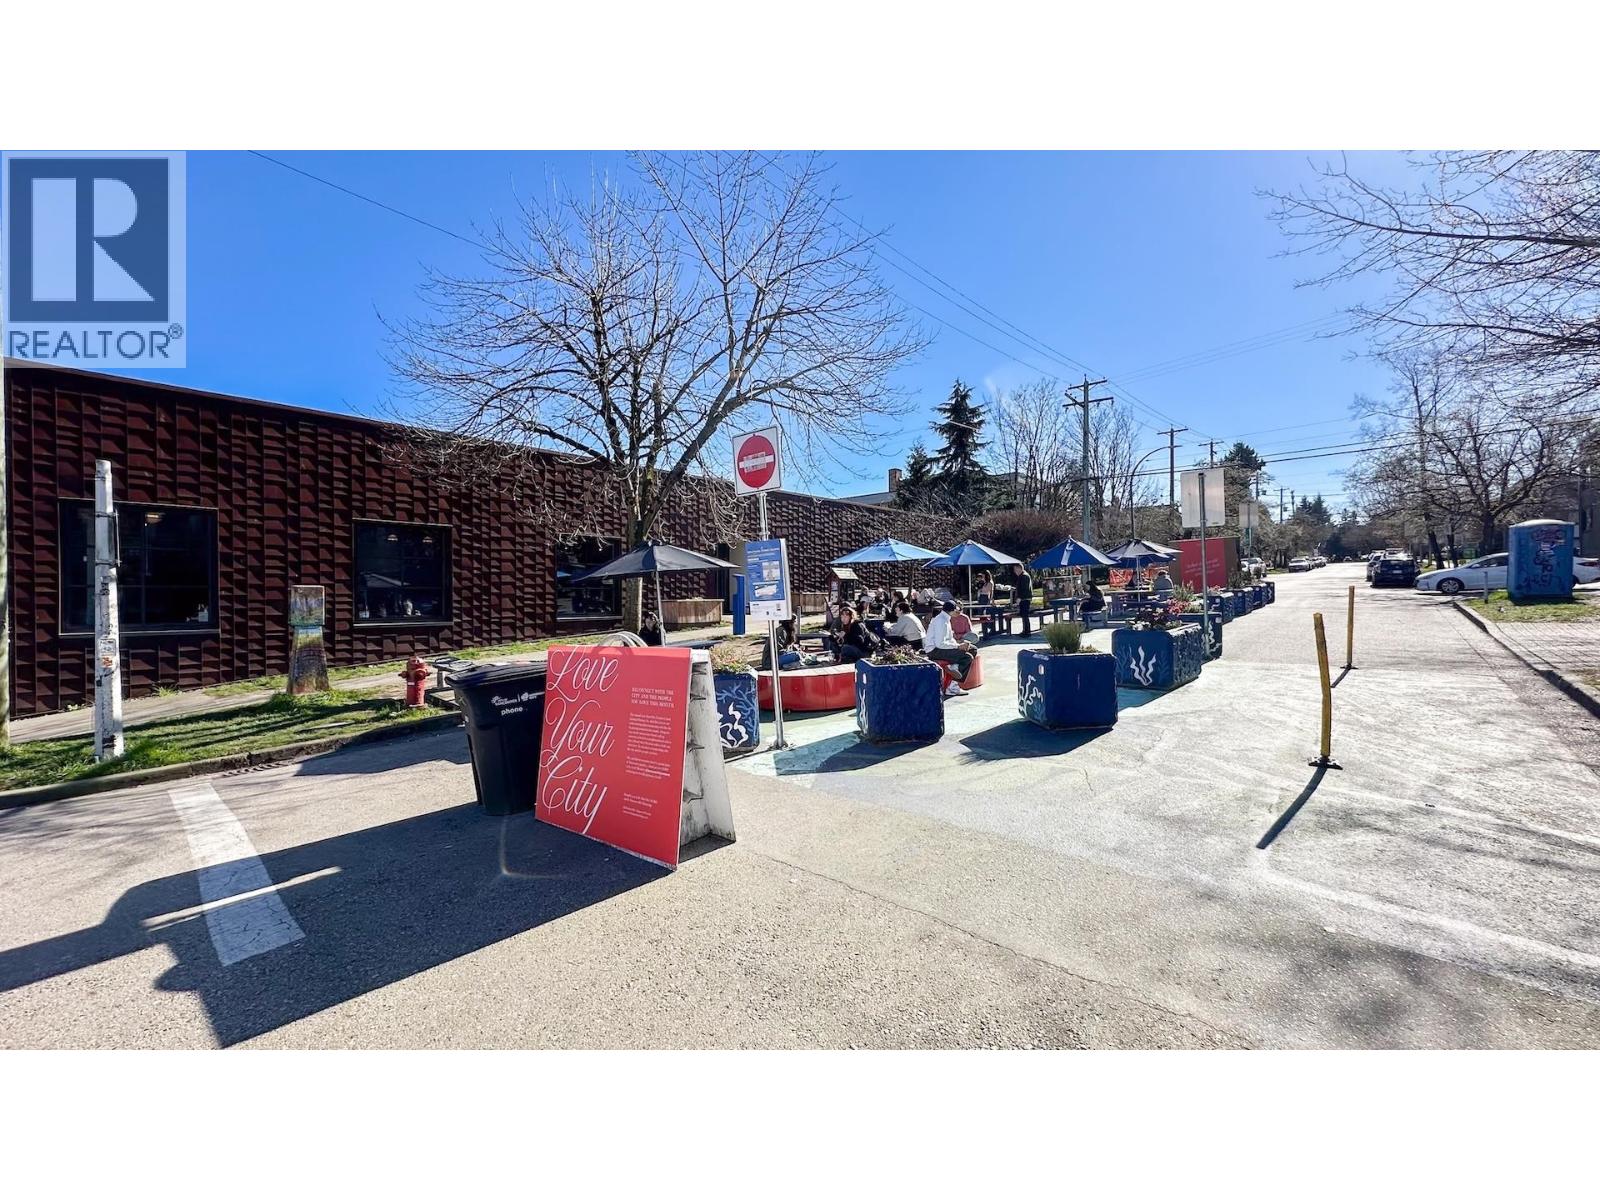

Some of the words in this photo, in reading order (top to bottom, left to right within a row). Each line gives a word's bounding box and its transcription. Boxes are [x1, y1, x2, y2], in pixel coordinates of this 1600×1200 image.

[546, 645, 618, 702] Love
[500, 706, 523, 716] phone
[540, 697, 615, 767] Your
[542, 755, 608, 834] City
